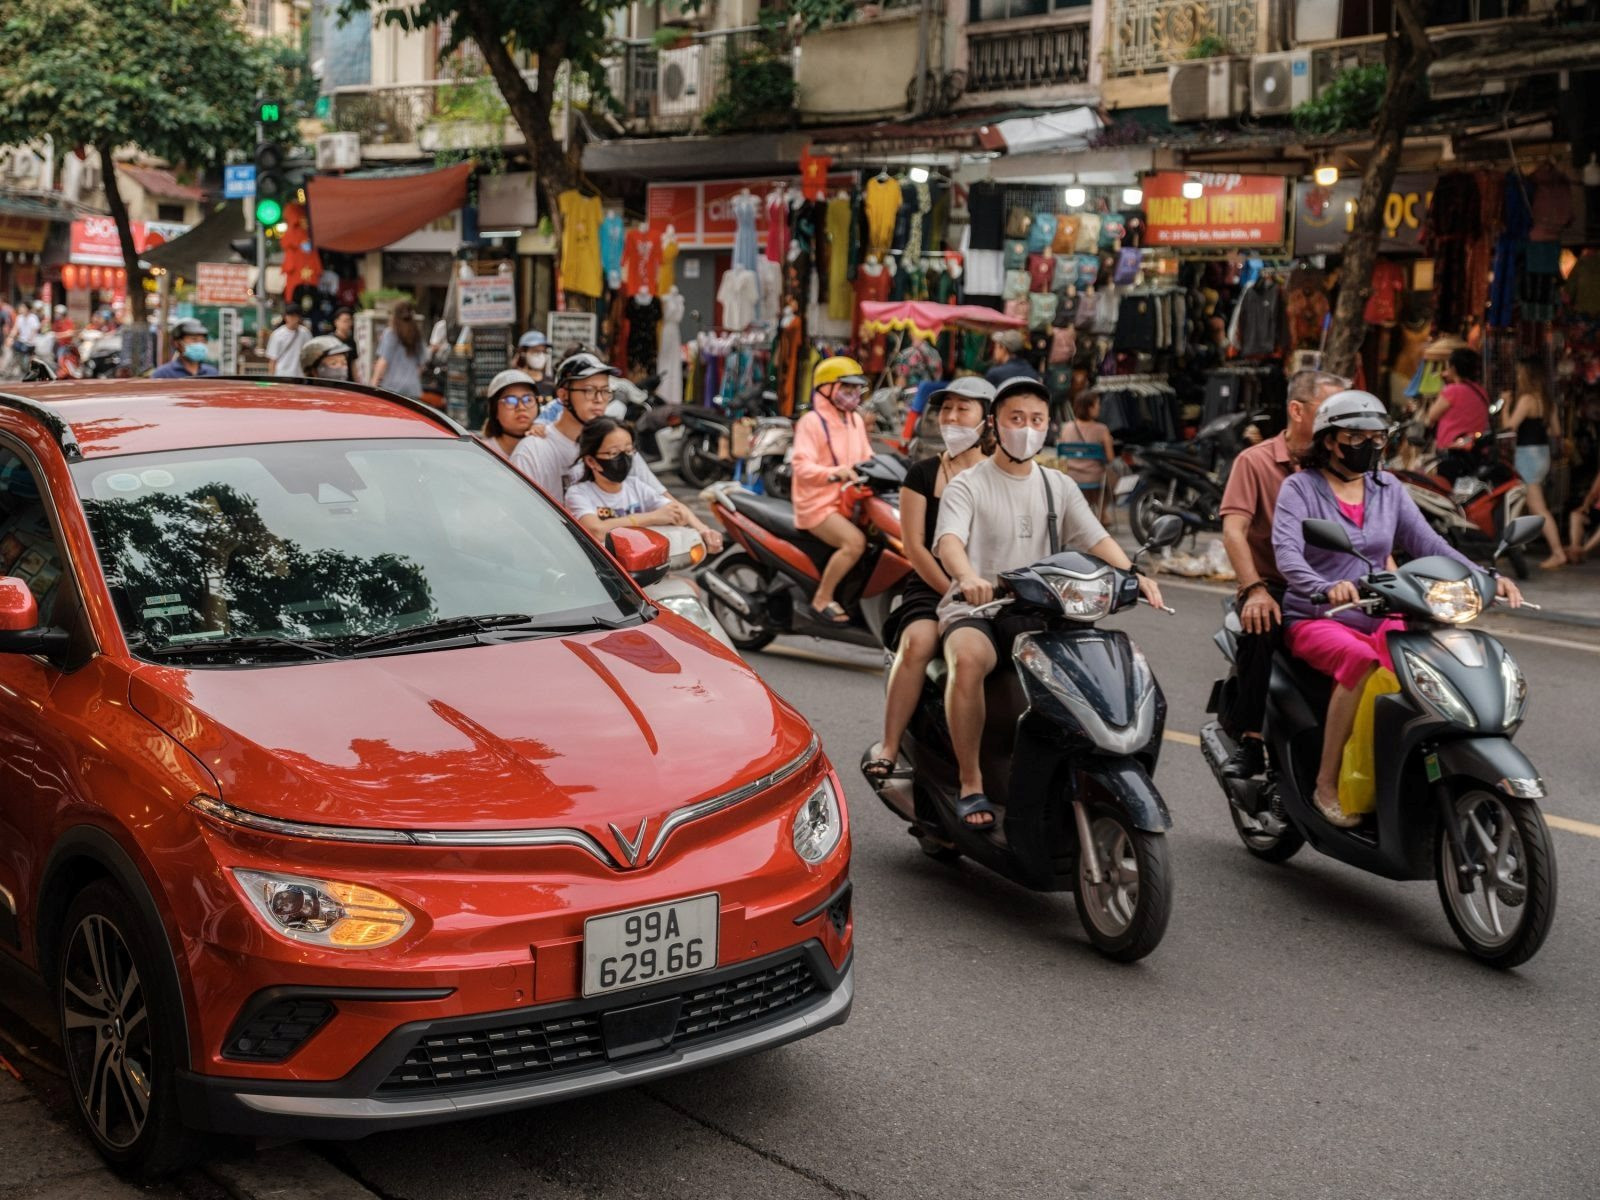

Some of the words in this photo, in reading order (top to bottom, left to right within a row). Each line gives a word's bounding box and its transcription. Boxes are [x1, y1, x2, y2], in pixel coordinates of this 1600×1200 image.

[1147, 197, 1188, 226] MADE
[1190, 197, 1208, 225] IN
[1210, 193, 1277, 224] VIETNAM
[625, 908, 680, 947] 99A
[600, 938, 703, 988] 629.66
